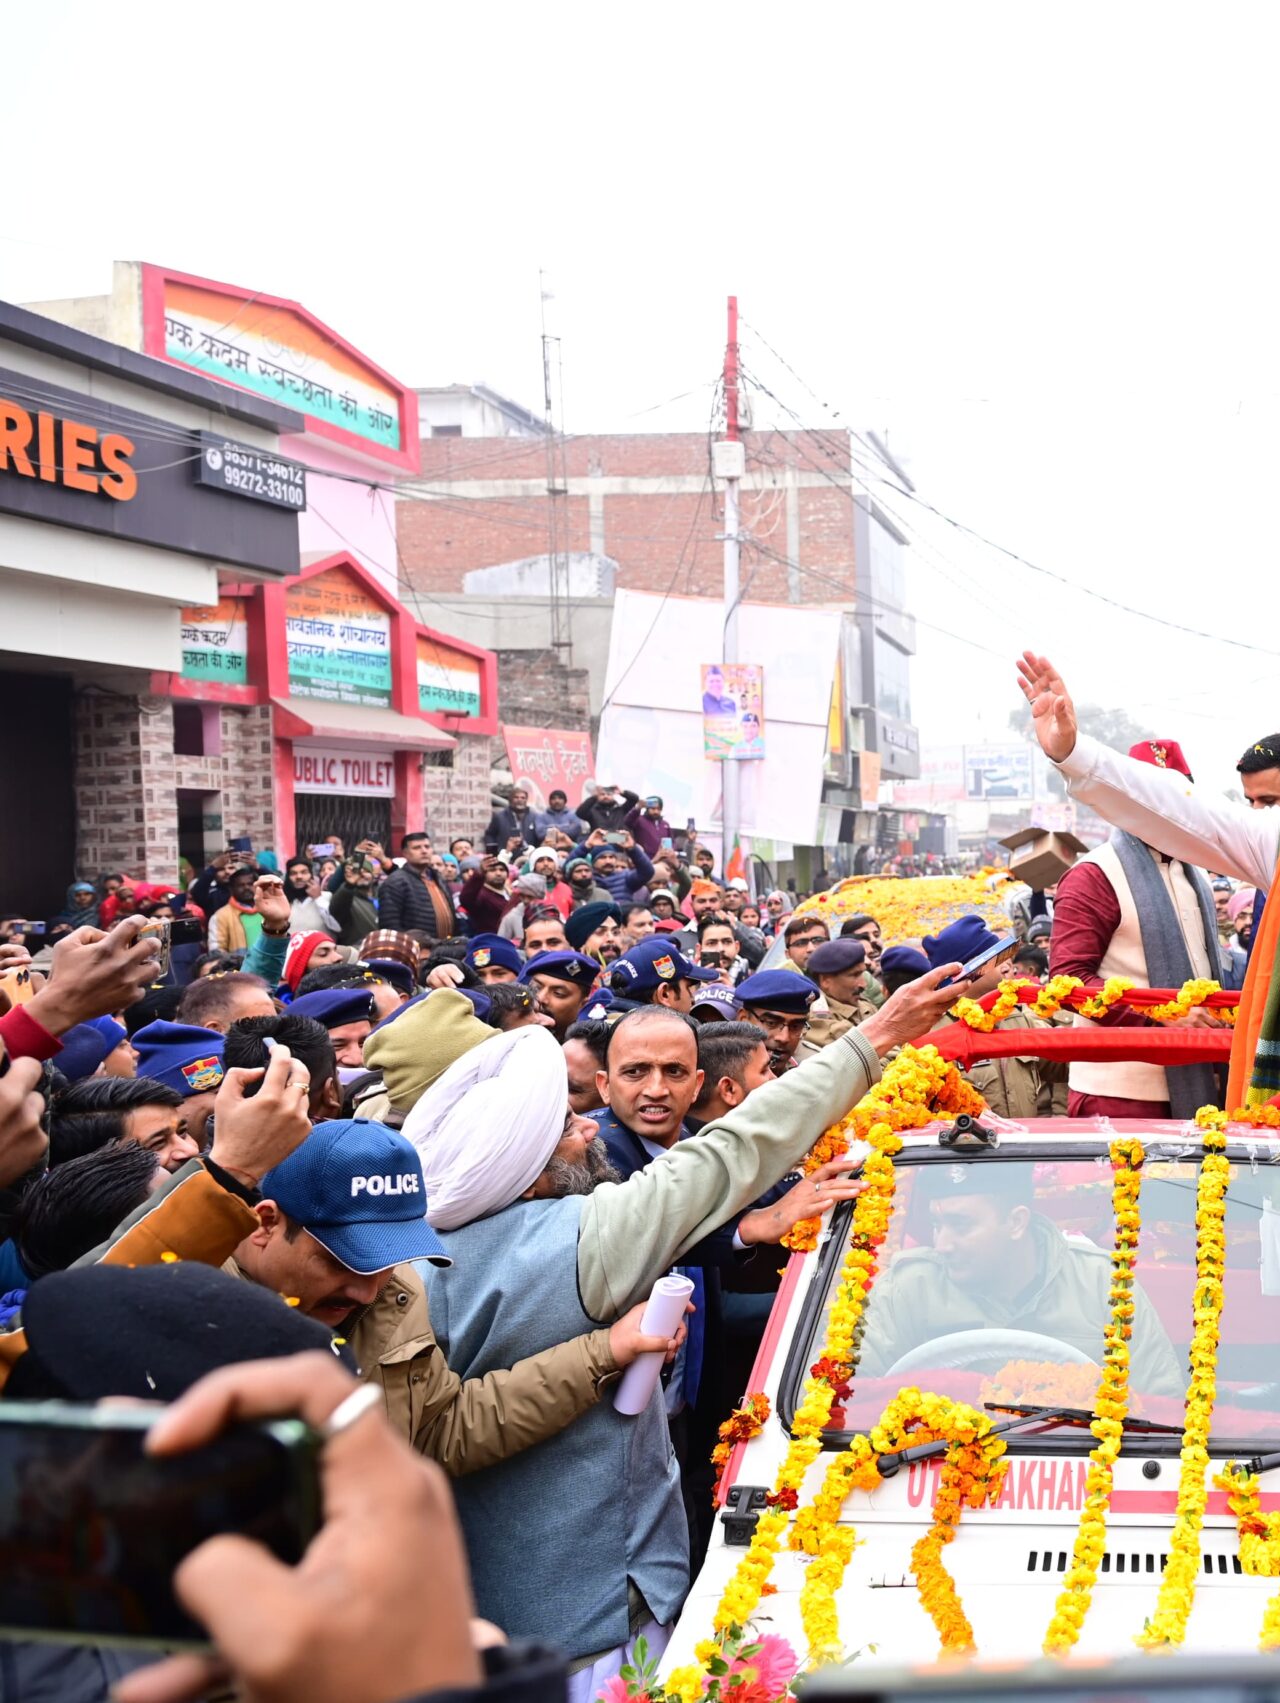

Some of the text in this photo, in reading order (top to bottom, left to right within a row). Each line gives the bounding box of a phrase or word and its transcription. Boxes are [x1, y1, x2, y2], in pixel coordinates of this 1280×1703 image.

[200, 331, 250, 374] कदम
[339, 390, 358, 420] की
[224, 465, 303, 506] 99272-33100
[341, 759, 393, 787] TOILET
[351, 1173, 420, 1197] POLICE
